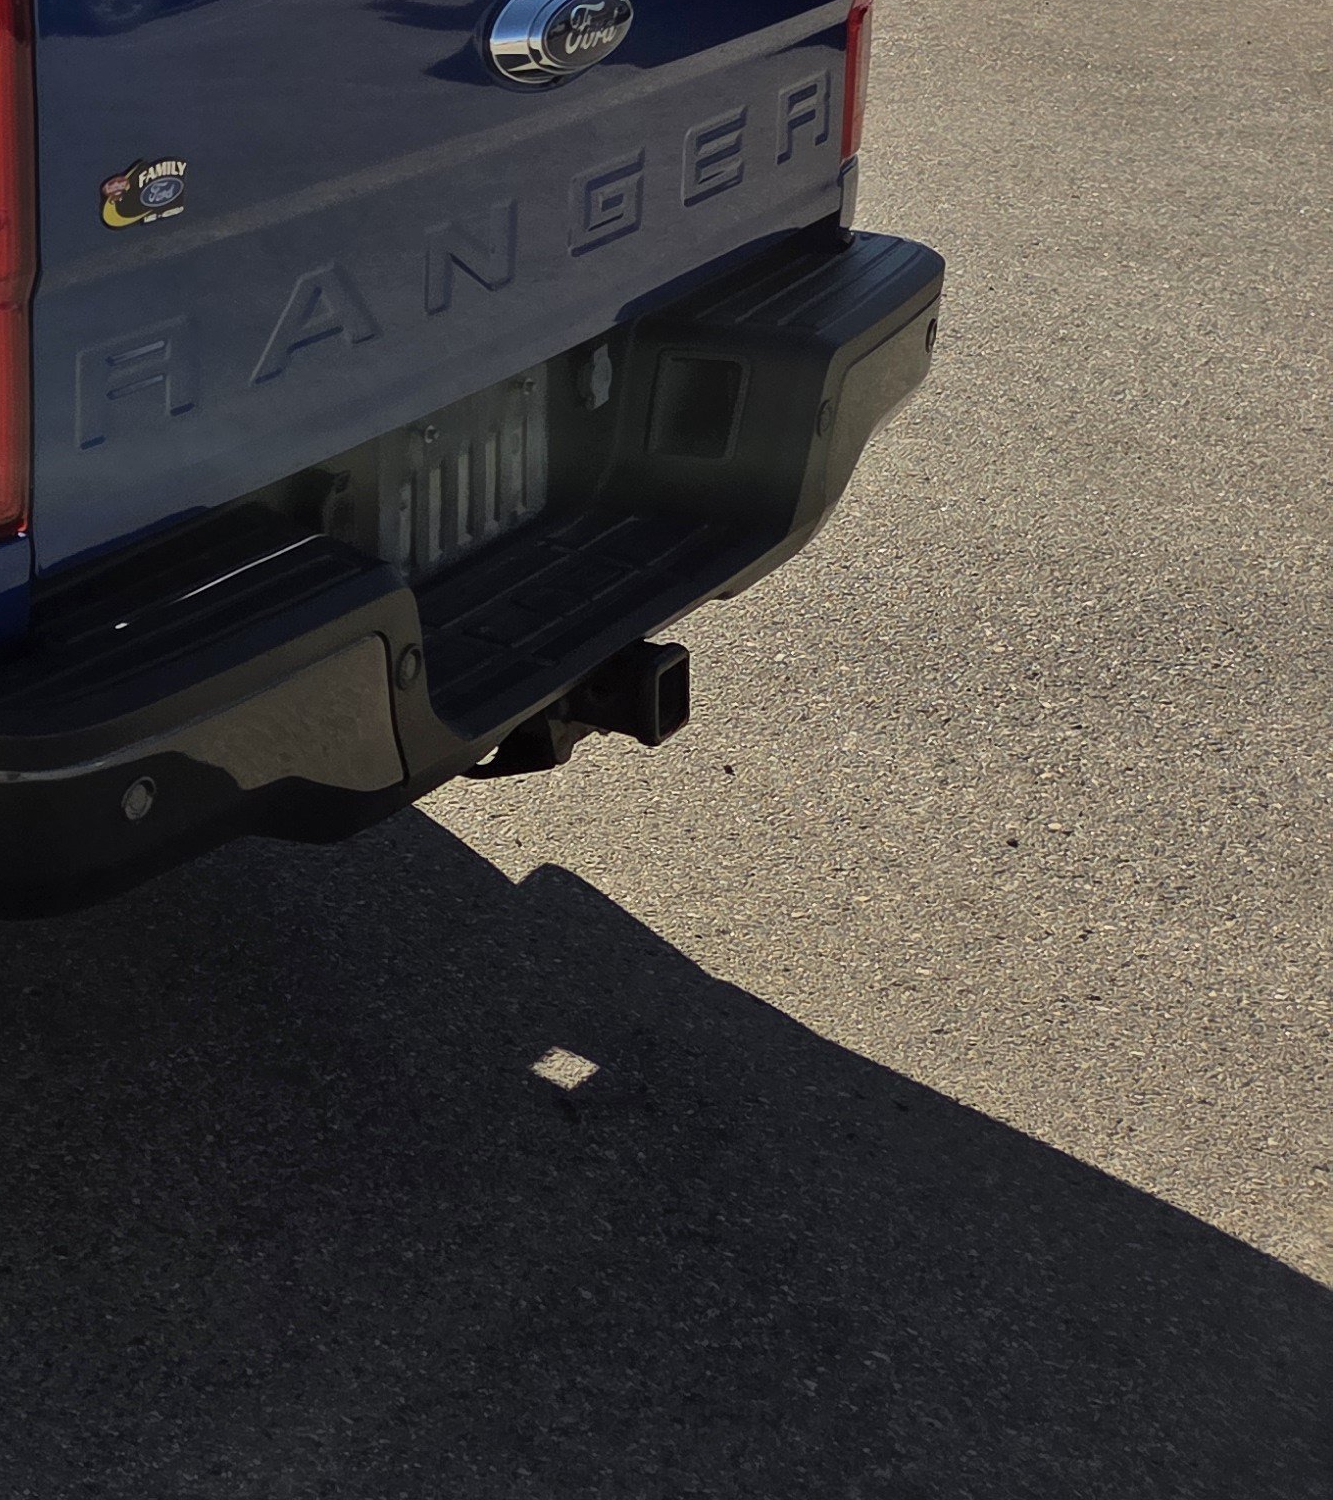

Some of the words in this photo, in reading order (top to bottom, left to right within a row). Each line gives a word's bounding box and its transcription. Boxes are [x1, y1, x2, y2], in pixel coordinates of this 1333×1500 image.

[565, 1, 620, 55] Ford
[138, 160, 187, 188] FAMILY
[148, 181, 175, 203] Ford
[74, 70, 832, 451] RANGER
